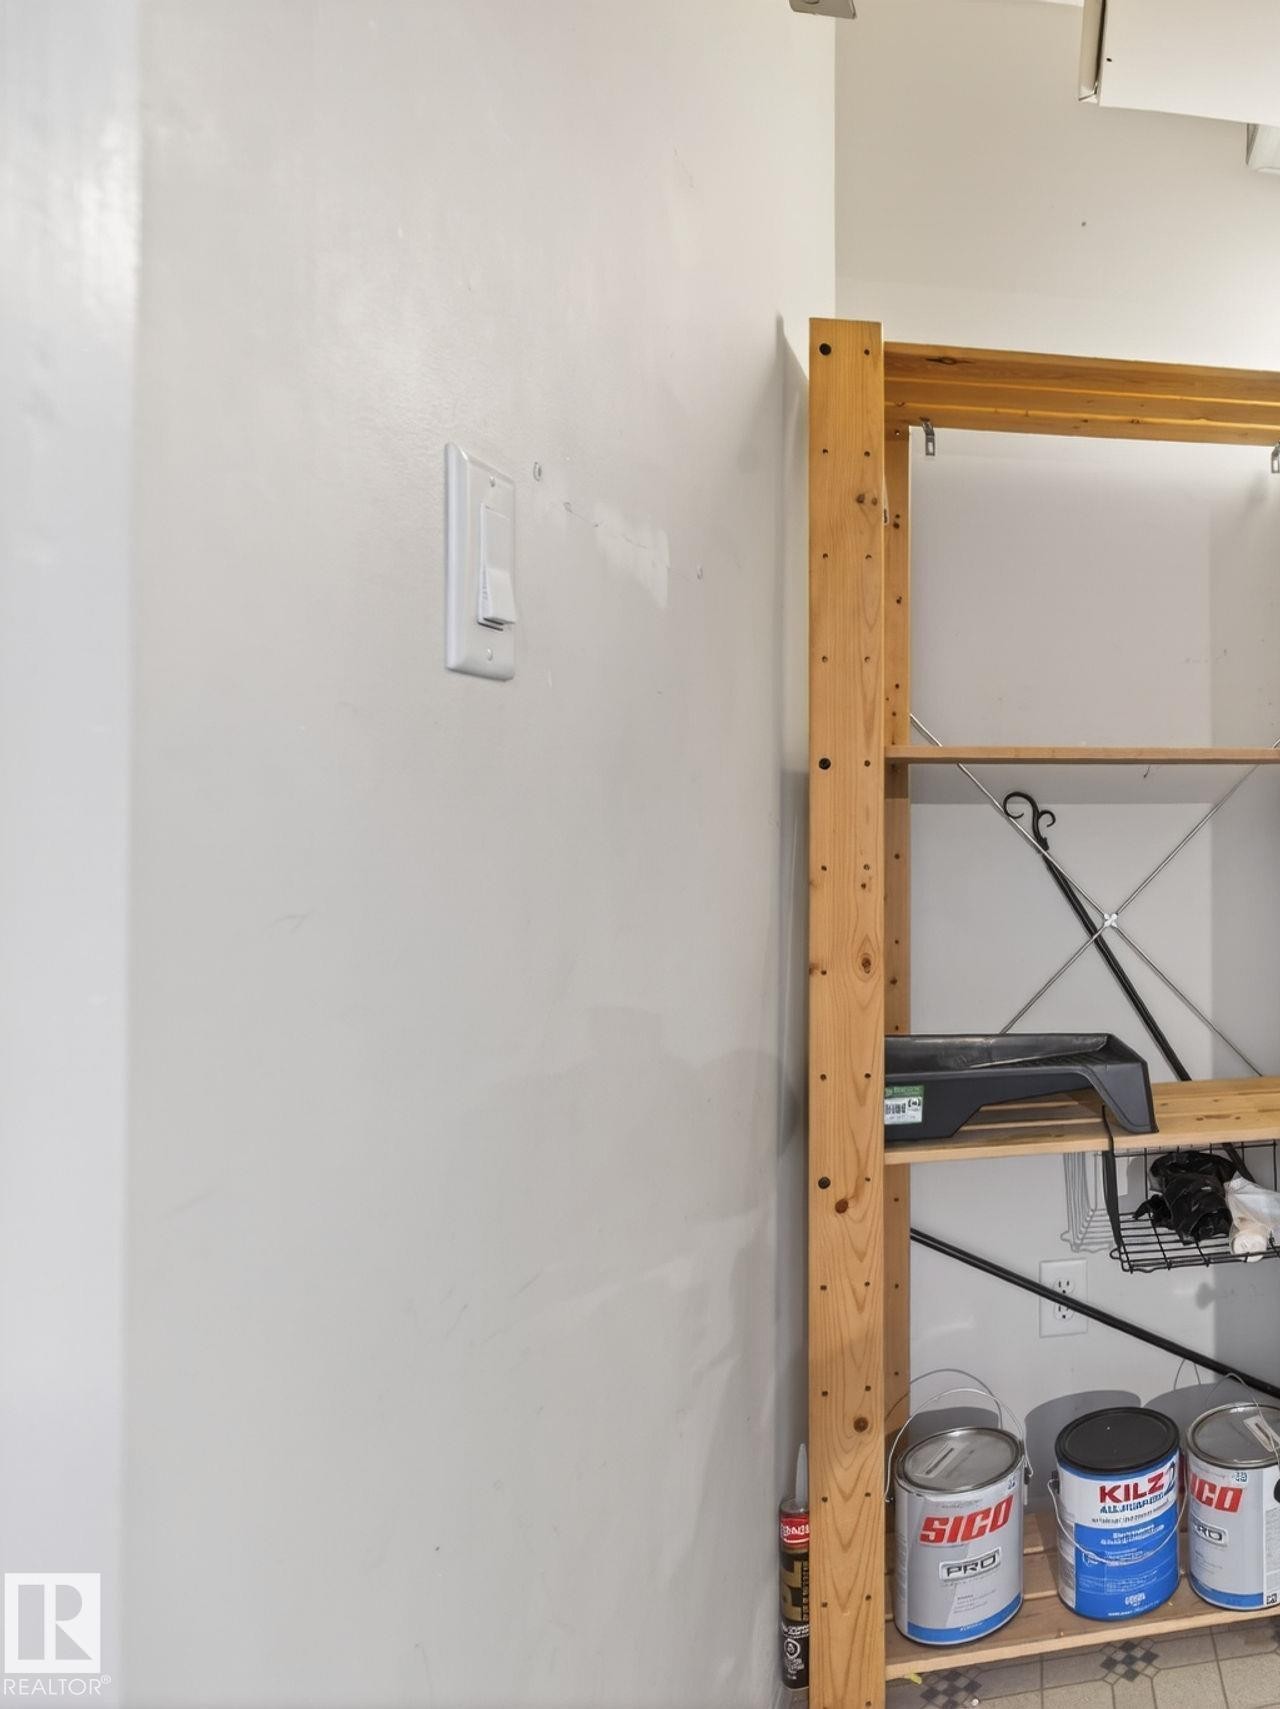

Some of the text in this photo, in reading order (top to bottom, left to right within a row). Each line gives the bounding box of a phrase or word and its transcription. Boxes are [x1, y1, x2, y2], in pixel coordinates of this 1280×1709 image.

[1099, 1471, 1165, 1504] KILZ
[1189, 1472, 1243, 1515] ICO
[919, 1494, 1014, 1545] SICO
[946, 1554, 997, 1578] PRO
